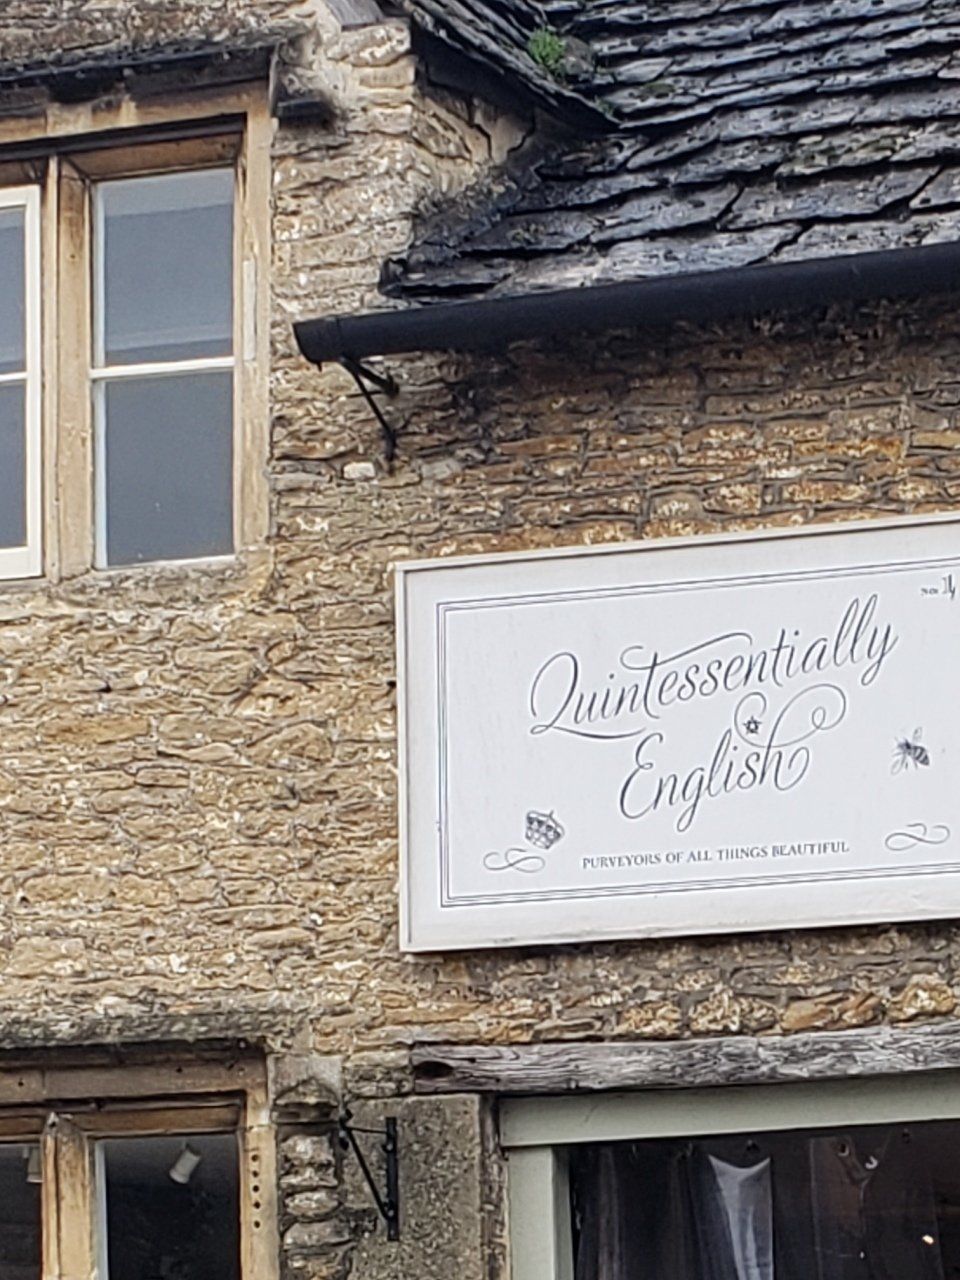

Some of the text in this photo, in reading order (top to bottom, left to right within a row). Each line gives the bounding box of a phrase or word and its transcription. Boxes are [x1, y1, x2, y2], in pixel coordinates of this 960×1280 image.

[531, 594, 898, 738] Quintessentially
[620, 684, 846, 832] English
[582, 841, 850, 869] PURVEYORS OF ALL THINGS BEAUTIFUL
